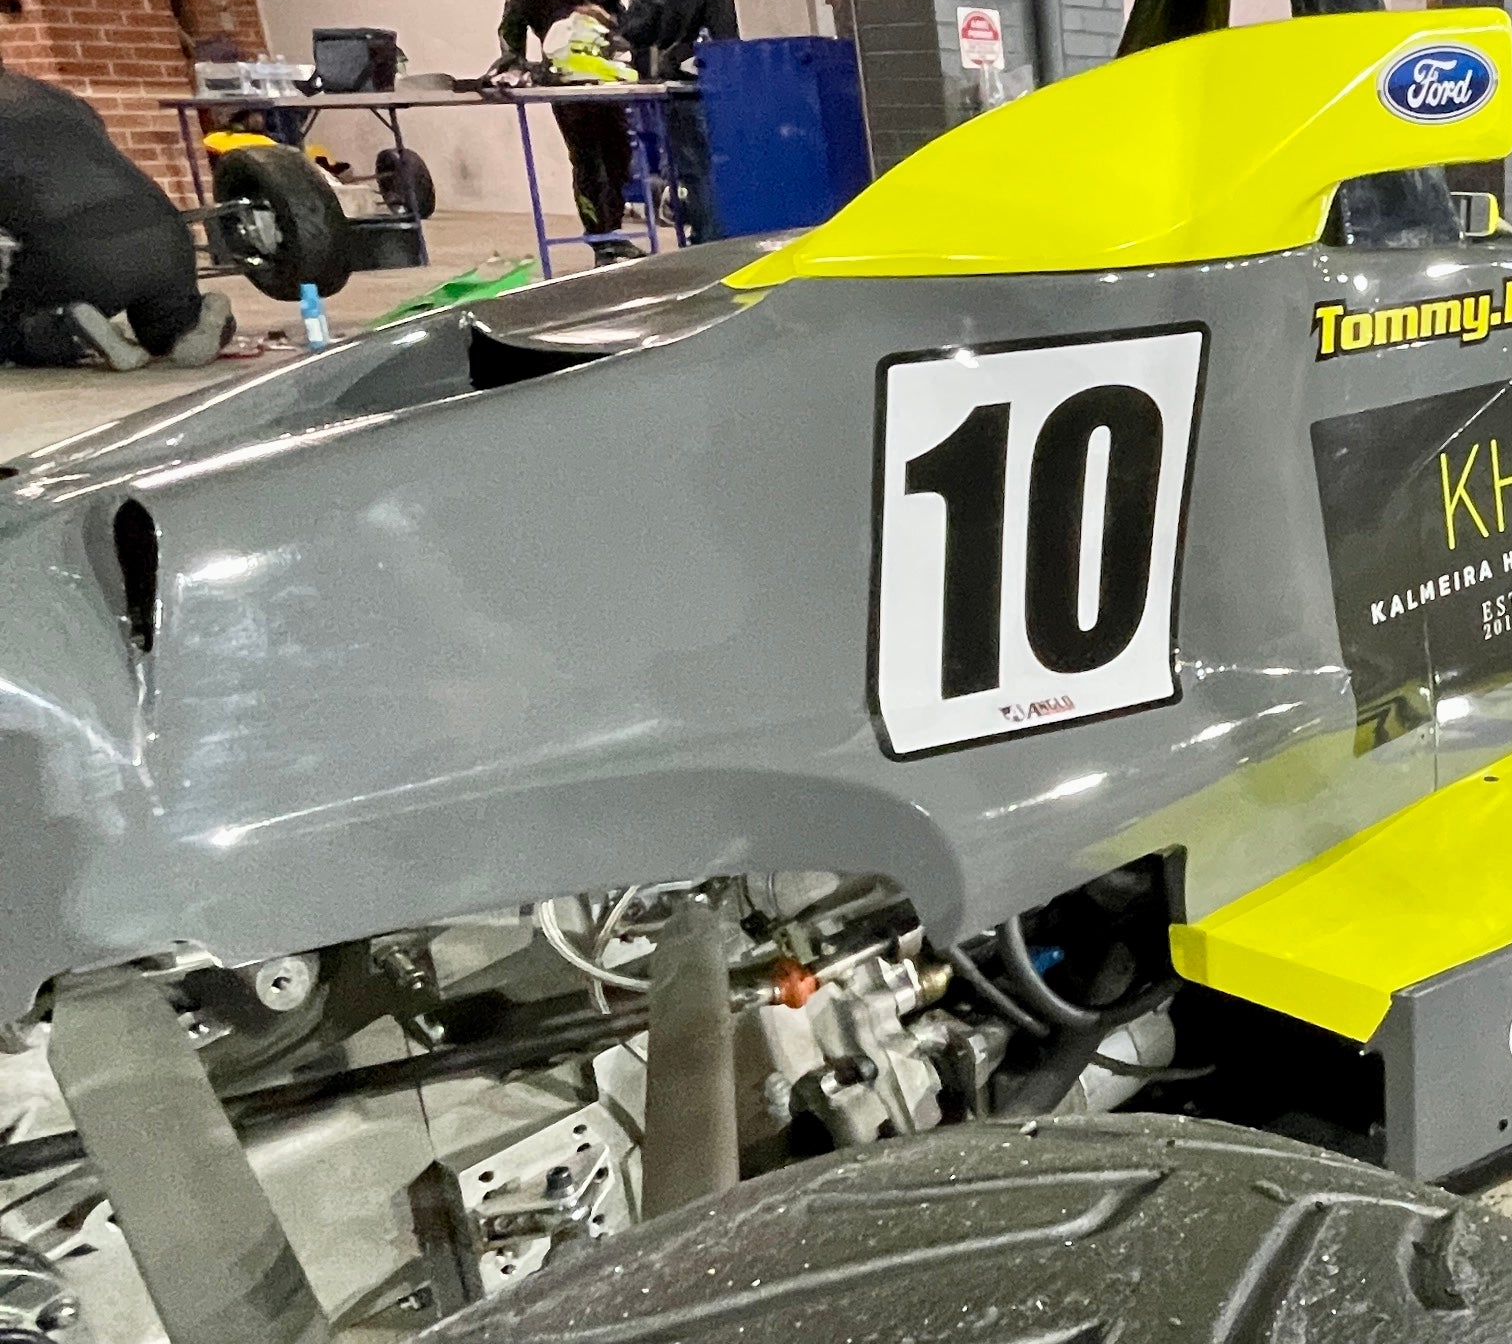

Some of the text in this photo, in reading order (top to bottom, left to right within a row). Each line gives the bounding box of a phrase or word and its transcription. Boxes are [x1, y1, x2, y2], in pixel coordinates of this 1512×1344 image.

[1407, 58, 1473, 108] Ford
[904, 384, 1165, 701] 10
[1370, 559, 1493, 625] KALMEIRA
